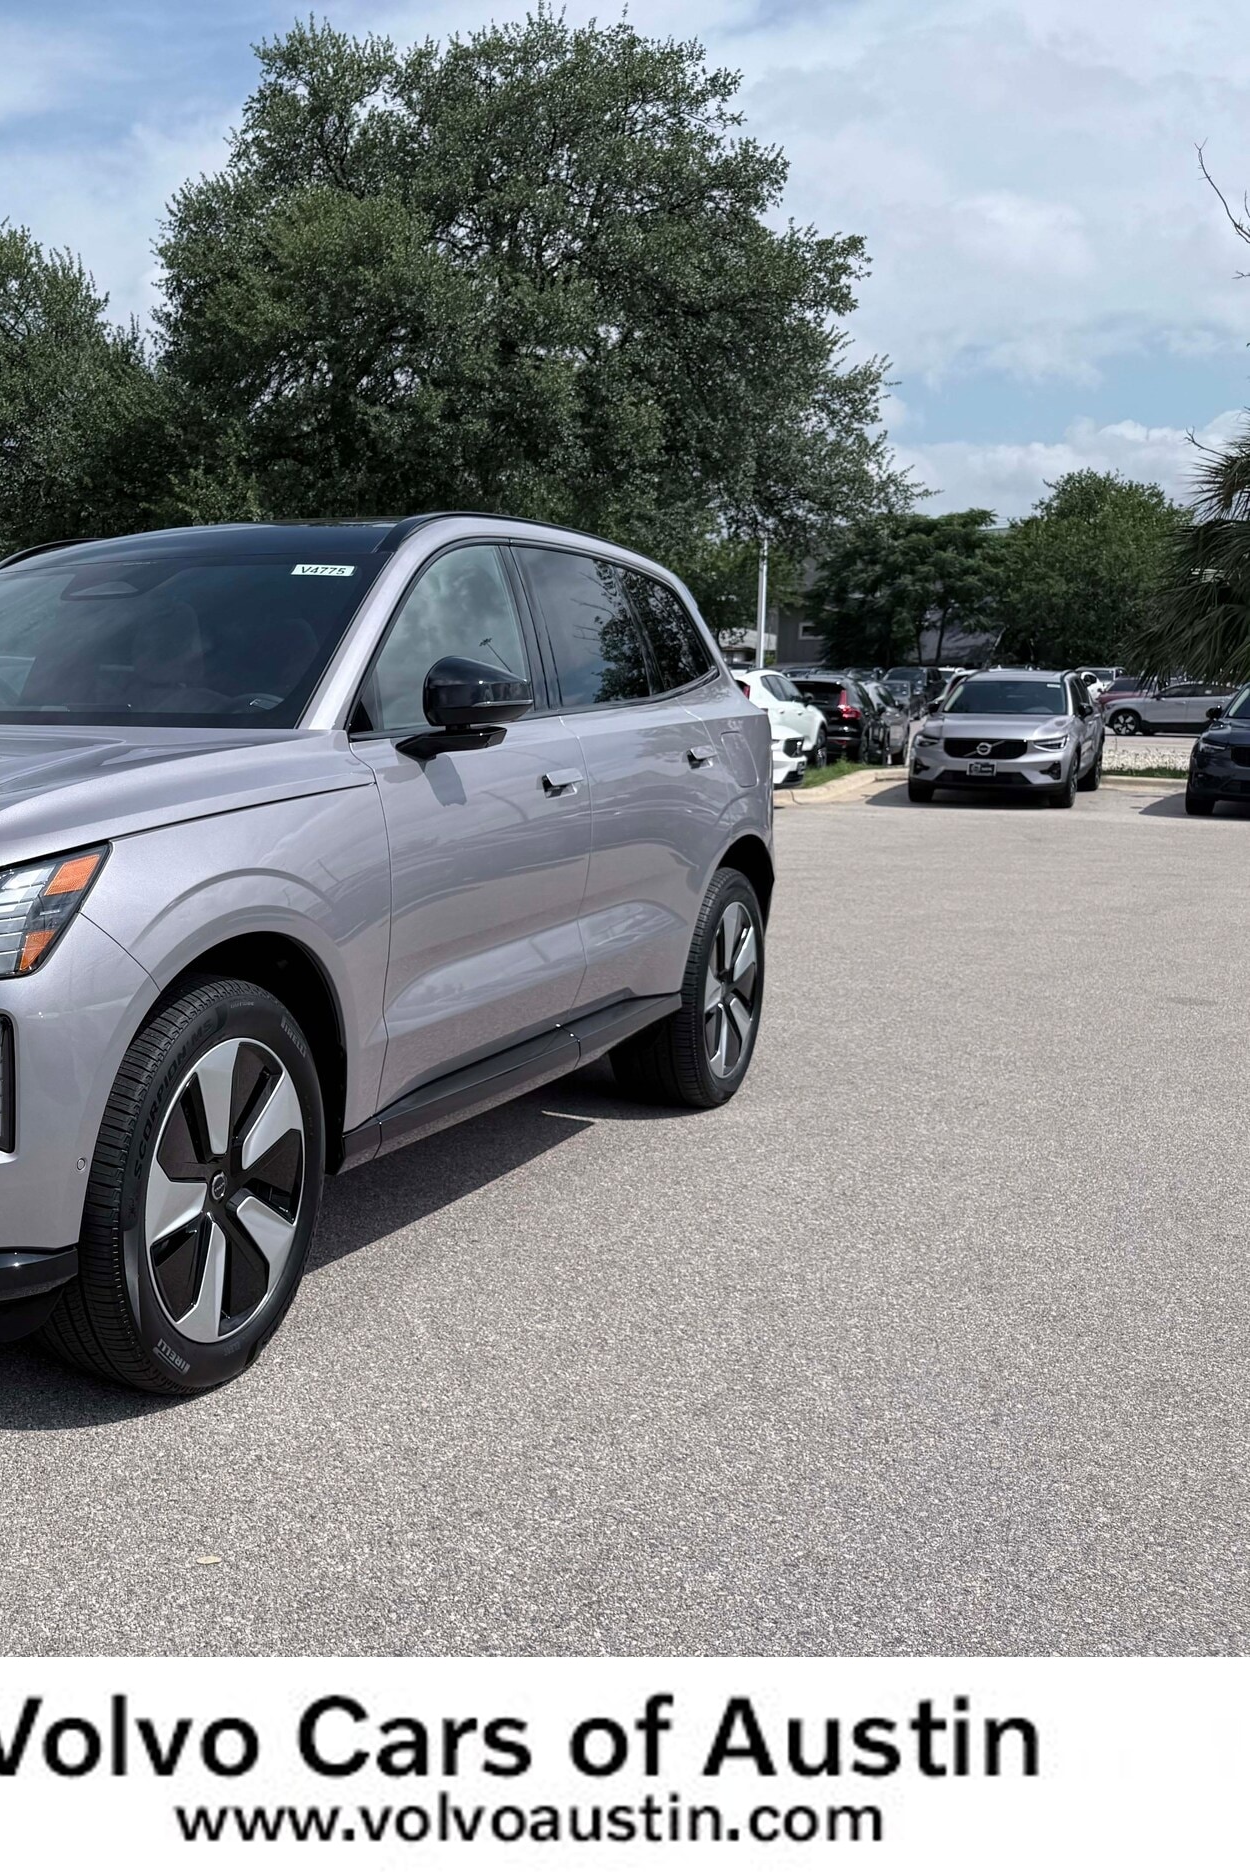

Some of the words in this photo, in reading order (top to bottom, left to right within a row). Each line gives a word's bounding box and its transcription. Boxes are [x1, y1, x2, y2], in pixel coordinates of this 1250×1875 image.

[301, 566, 347, 575] V4775
[133, 1045, 188, 1180] SCORPION
[152, 1338, 191, 1375] PIRELLI
